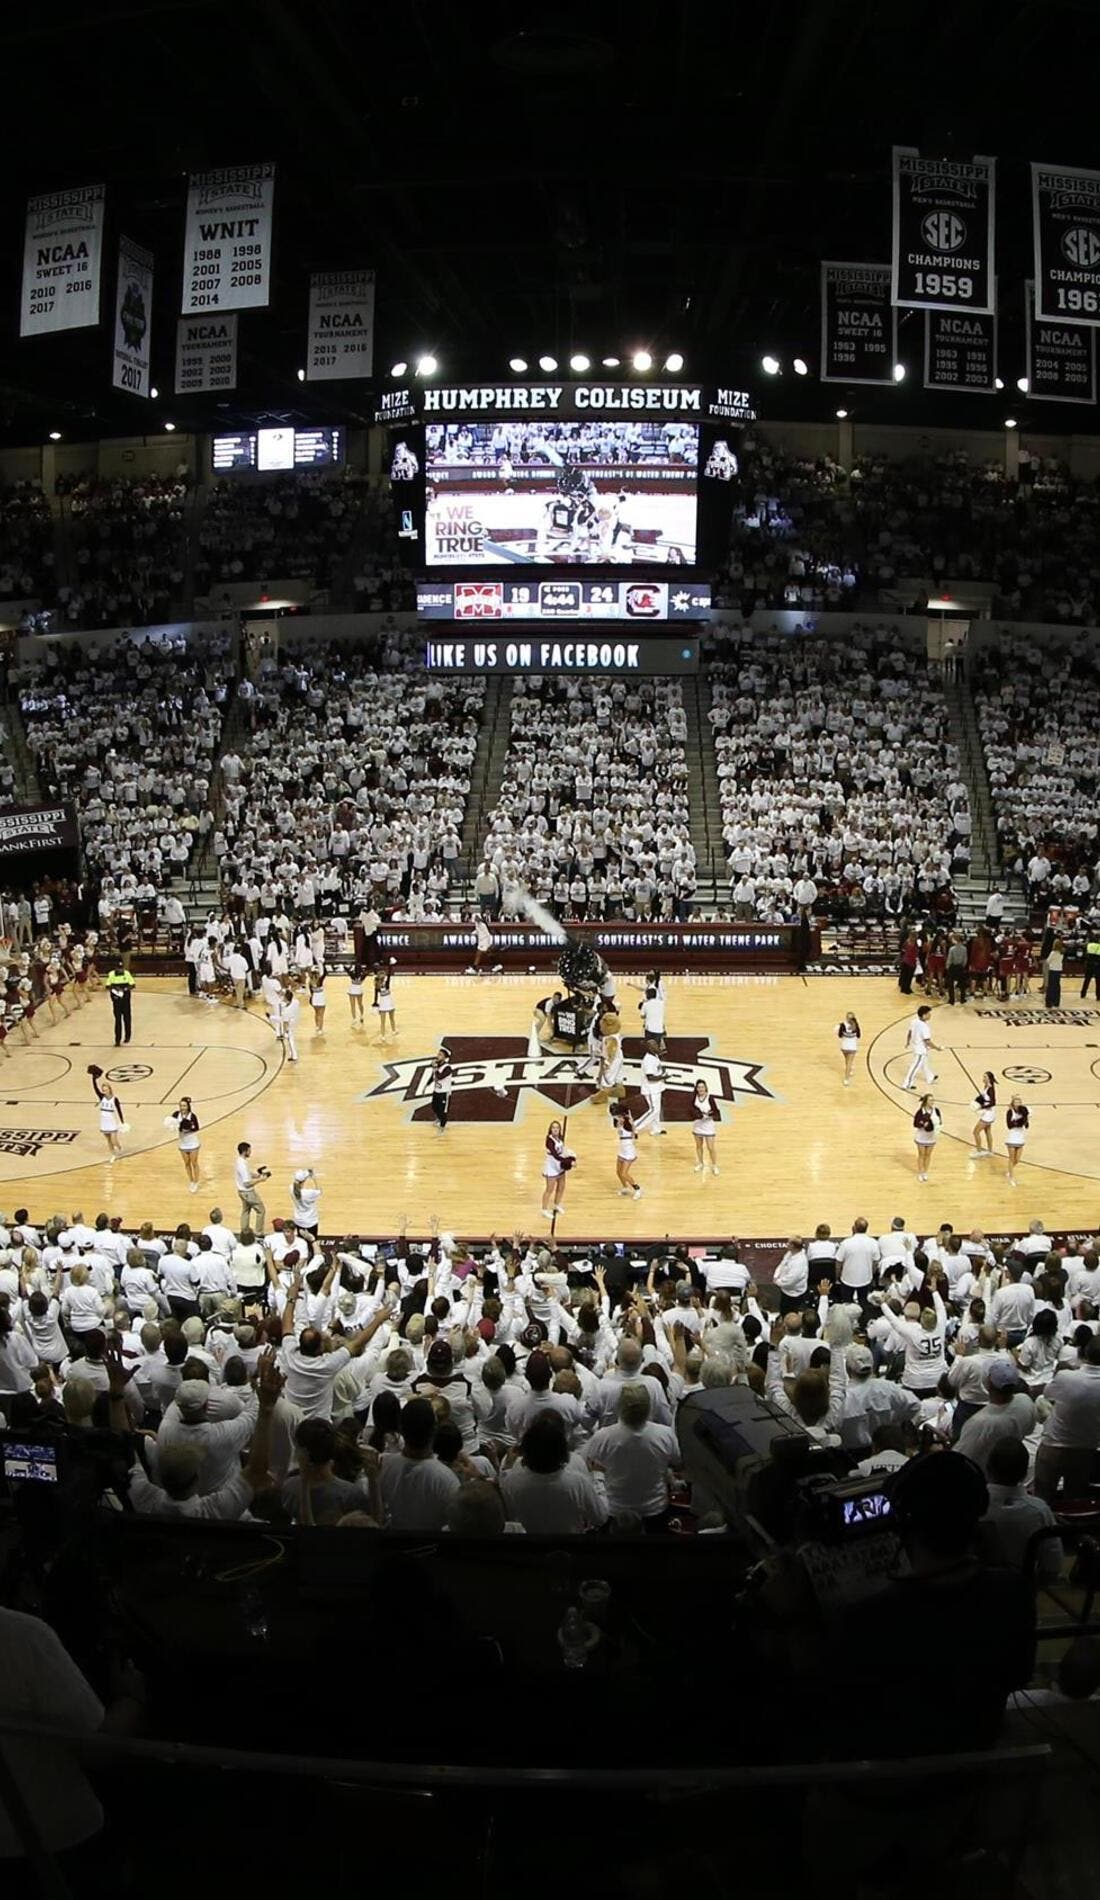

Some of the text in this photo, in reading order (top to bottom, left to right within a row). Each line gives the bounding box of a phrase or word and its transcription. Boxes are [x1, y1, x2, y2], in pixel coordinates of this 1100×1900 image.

[190, 164, 275, 187] MISSISSIPPI
[899, 158, 989, 180] MISSISSIPPI
[211, 182, 249, 199] STATE
[924, 175, 966, 193] STATE
[28, 185, 105, 212] MISSISSIPPI
[49, 206, 83, 223] STATE
[199, 219, 259, 241] WNIT
[924, 212, 964, 250] SEC
[37, 242, 89, 267] NCAA
[194, 245, 261, 262] 1988 1998
[1064, 228, 1100, 266] SEC
[36, 262, 88, 279] SWEET 16
[193, 259, 262, 277] 2001 2005
[907, 255, 981, 271] CHAMPIONS
[31, 280, 91, 300] 2010 2016
[191, 274, 261, 292] 2007 2008
[914, 271, 974, 299] 1959
[30, 301, 54, 315] 2017
[191, 294, 219, 307] 2014
[1056, 287, 1100, 314] 196
[320, 313, 363, 328] NCAA
[837, 311, 883, 328] NCAA
[940, 318, 984, 336] NCAA
[188, 325, 228, 341] NCAA
[314, 328, 368, 339] TOURNAMENT
[837, 326, 869, 337] SWEET
[1040, 329, 1082, 347] NCAA
[314, 344, 337, 355] 2015
[313, 356, 336, 367] 2017
[121, 363, 142, 391] 2017
[381, 389, 409, 410] MIZE
[424, 387, 701, 411] HUMPHREY COLISEUM
[717, 388, 750, 408] MIZE
[709, 403, 757, 420] FOUNDATION
[447, 505, 474, 520] WE
[435, 521, 483, 536] RING
[435, 537, 484, 553] TRUE
[511, 587, 530, 604] 19
[591, 587, 614, 603] 24
[430, 644, 639, 668] LIKE US ON FACEBOOK
[6, 825, 46, 836] STATE
[443, 934, 478, 946] AWARD
[529, 934, 566, 947] DINING
[597, 935, 664, 947] SOUTHEAST'S
[682, 935, 716, 947] WATER
[719, 935, 752, 947] THEME
[755, 935, 781, 947] PARK
[446, 1060, 696, 1087] STAE
[920, 1336, 942, 1356] 35
